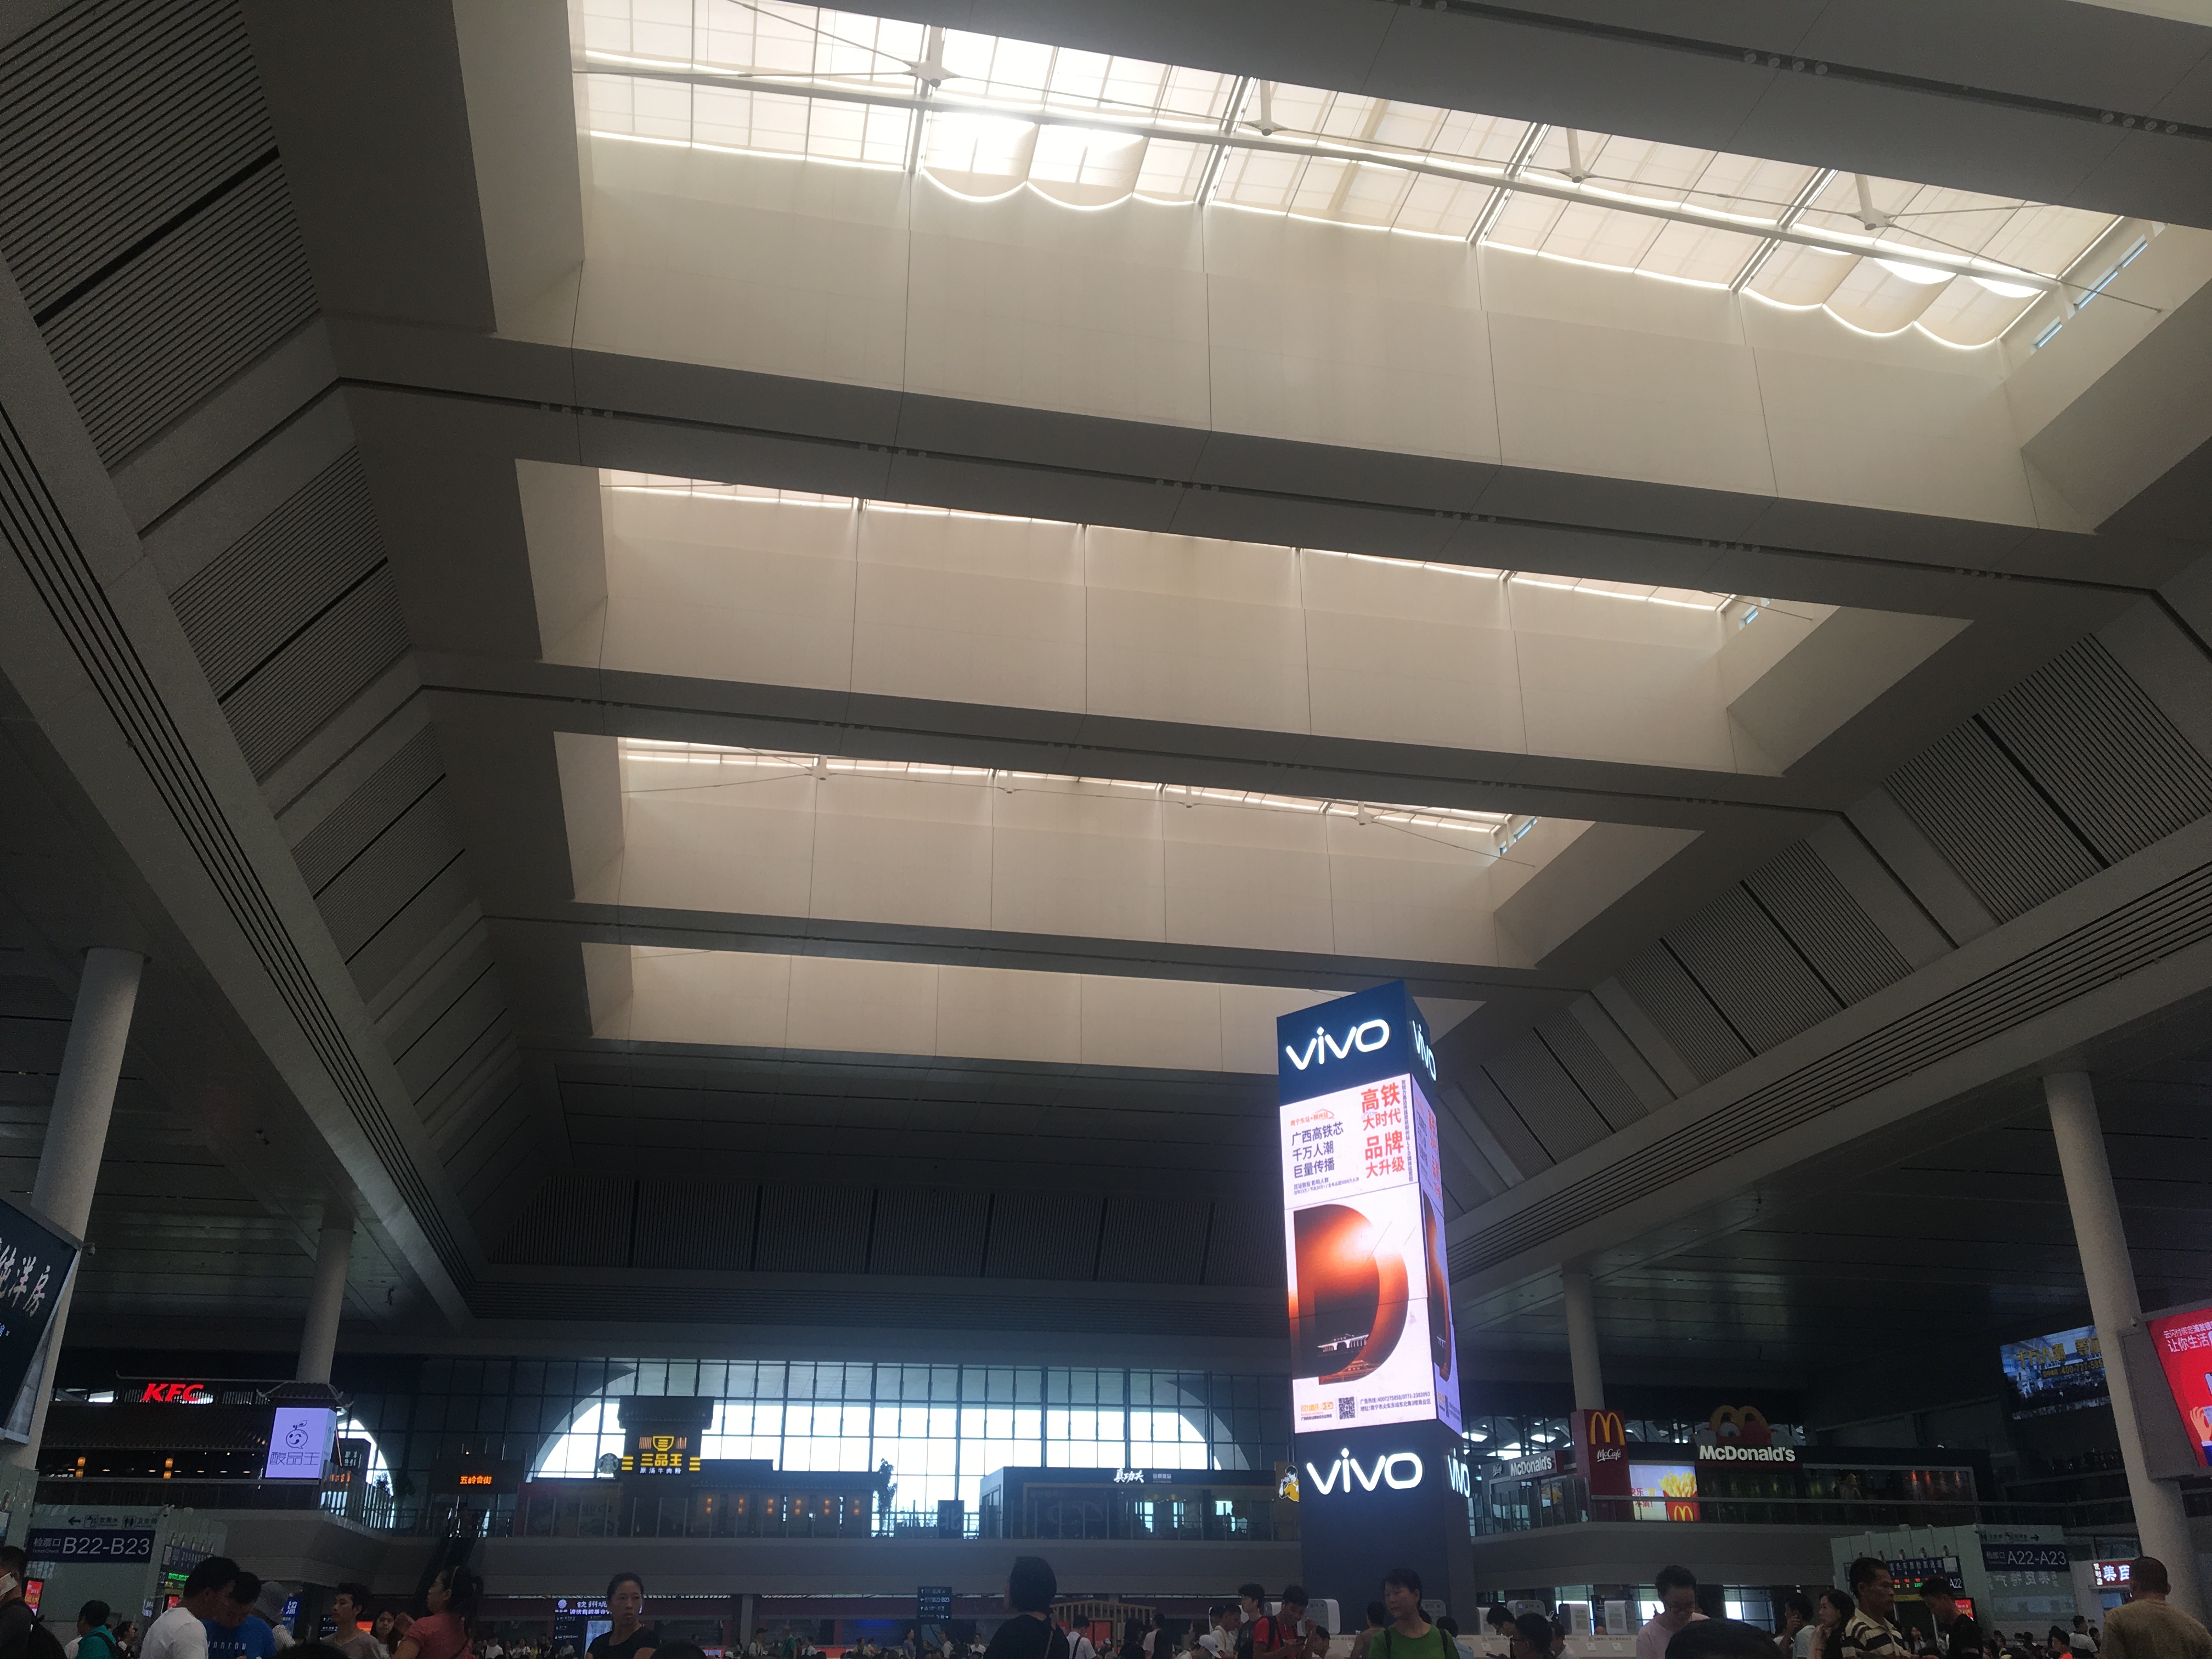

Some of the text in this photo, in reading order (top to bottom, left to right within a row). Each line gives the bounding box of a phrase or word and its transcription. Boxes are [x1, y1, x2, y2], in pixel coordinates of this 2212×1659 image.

[1286, 1019, 1390, 1070] vivo
[1412, 1020, 1436, 1081] vivo
[1361, 1082, 1401, 1113] 高铁
[1363, 1108, 1402, 1131] 大时代
[1292, 1121, 1344, 1146] 广西高铁芯
[1292, 1140, 1334, 1161] 千万人潮
[1365, 1130, 1404, 1160] 品牌
[1294, 1156, 1335, 1178] 巨量传播
[1365, 1156, 1405, 1179] 大升级
[2167, 1333, 2210, 1352] 让你生活
[142, 1383, 204, 1402] KFC
[269, 1452, 320, 1465] 酸品王
[640, 1453, 682, 1466] 三品王
[1597, 1448, 1622, 1462] McCafé
[1700, 1445, 1796, 1462] McDonald's
[1114, 1468, 1144, 1483] 真功夫
[1306, 1447, 1423, 1495] vivo
[1447, 1447, 1471, 1498] vivo
[1510, 1457, 1552, 1477] McDonald's
[940, 1508, 961, 1531] 北
[33, 1537, 150, 1555] 检票口 B22-B23
[2007, 1551, 2067, 1565] A22-A23
[1950, 1578, 1962, 1589] A22
